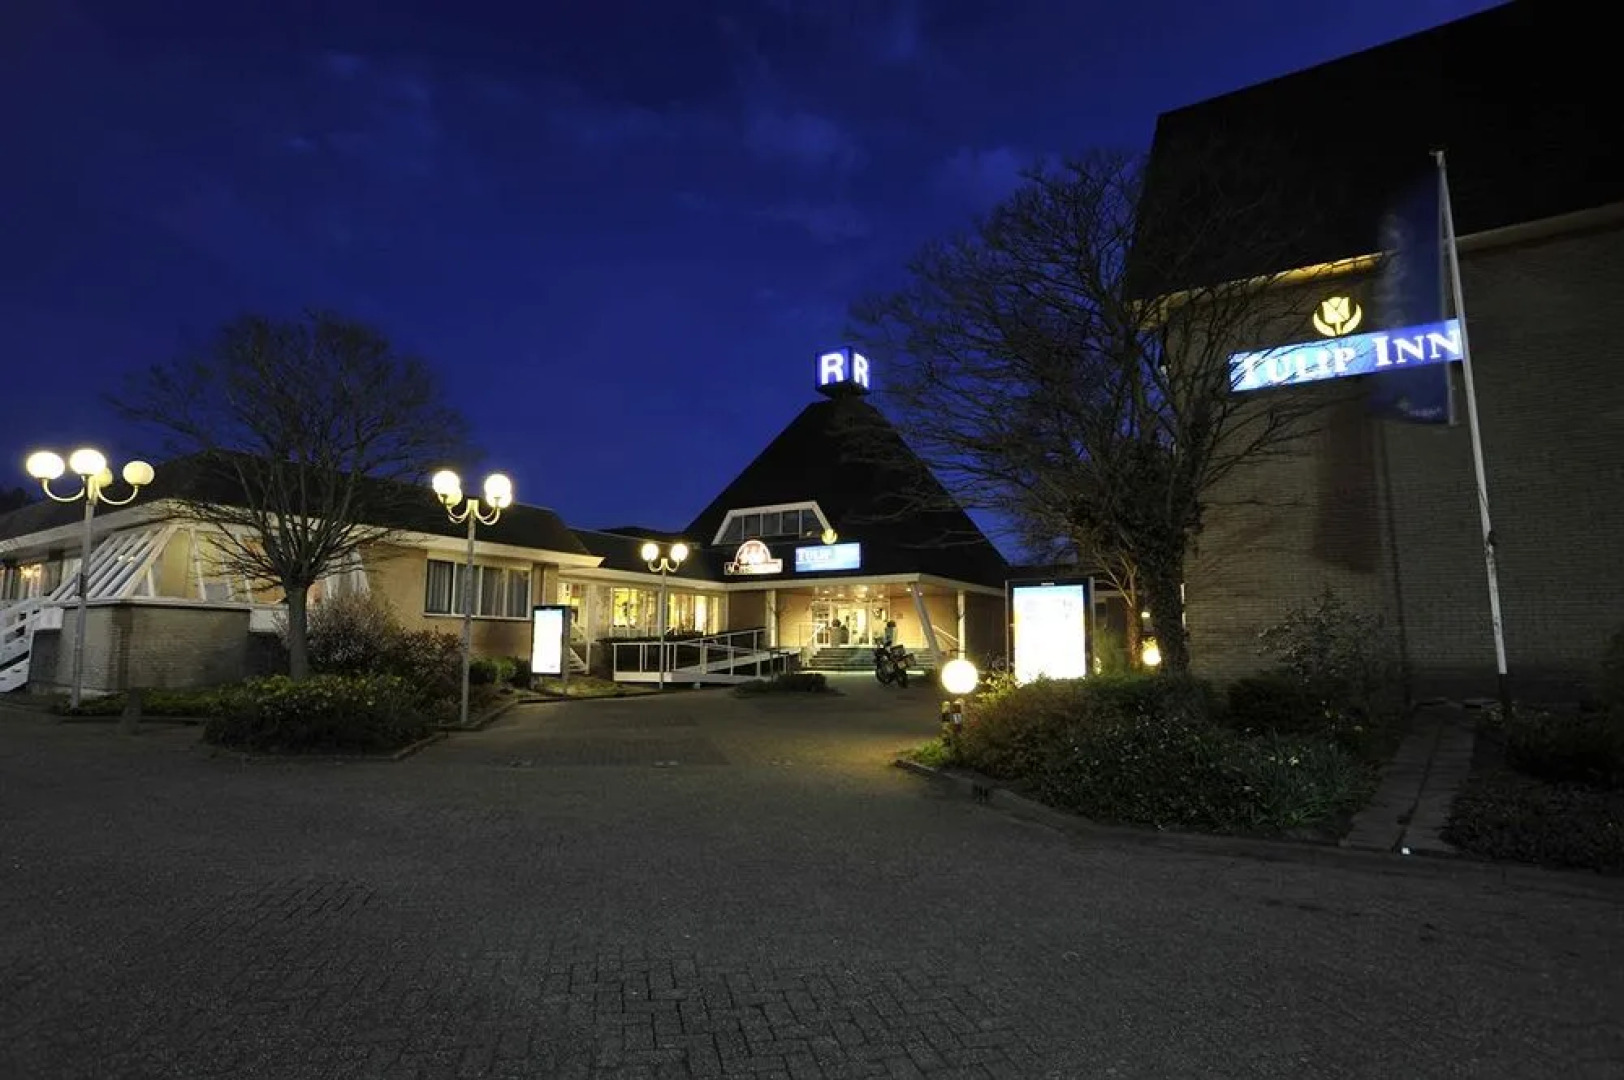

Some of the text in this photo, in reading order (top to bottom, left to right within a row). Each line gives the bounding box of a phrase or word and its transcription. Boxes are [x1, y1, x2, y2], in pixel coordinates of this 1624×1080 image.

[1372, 329, 1461, 366] INN
[821, 353, 843, 385] R
[853, 353, 868, 388] R
